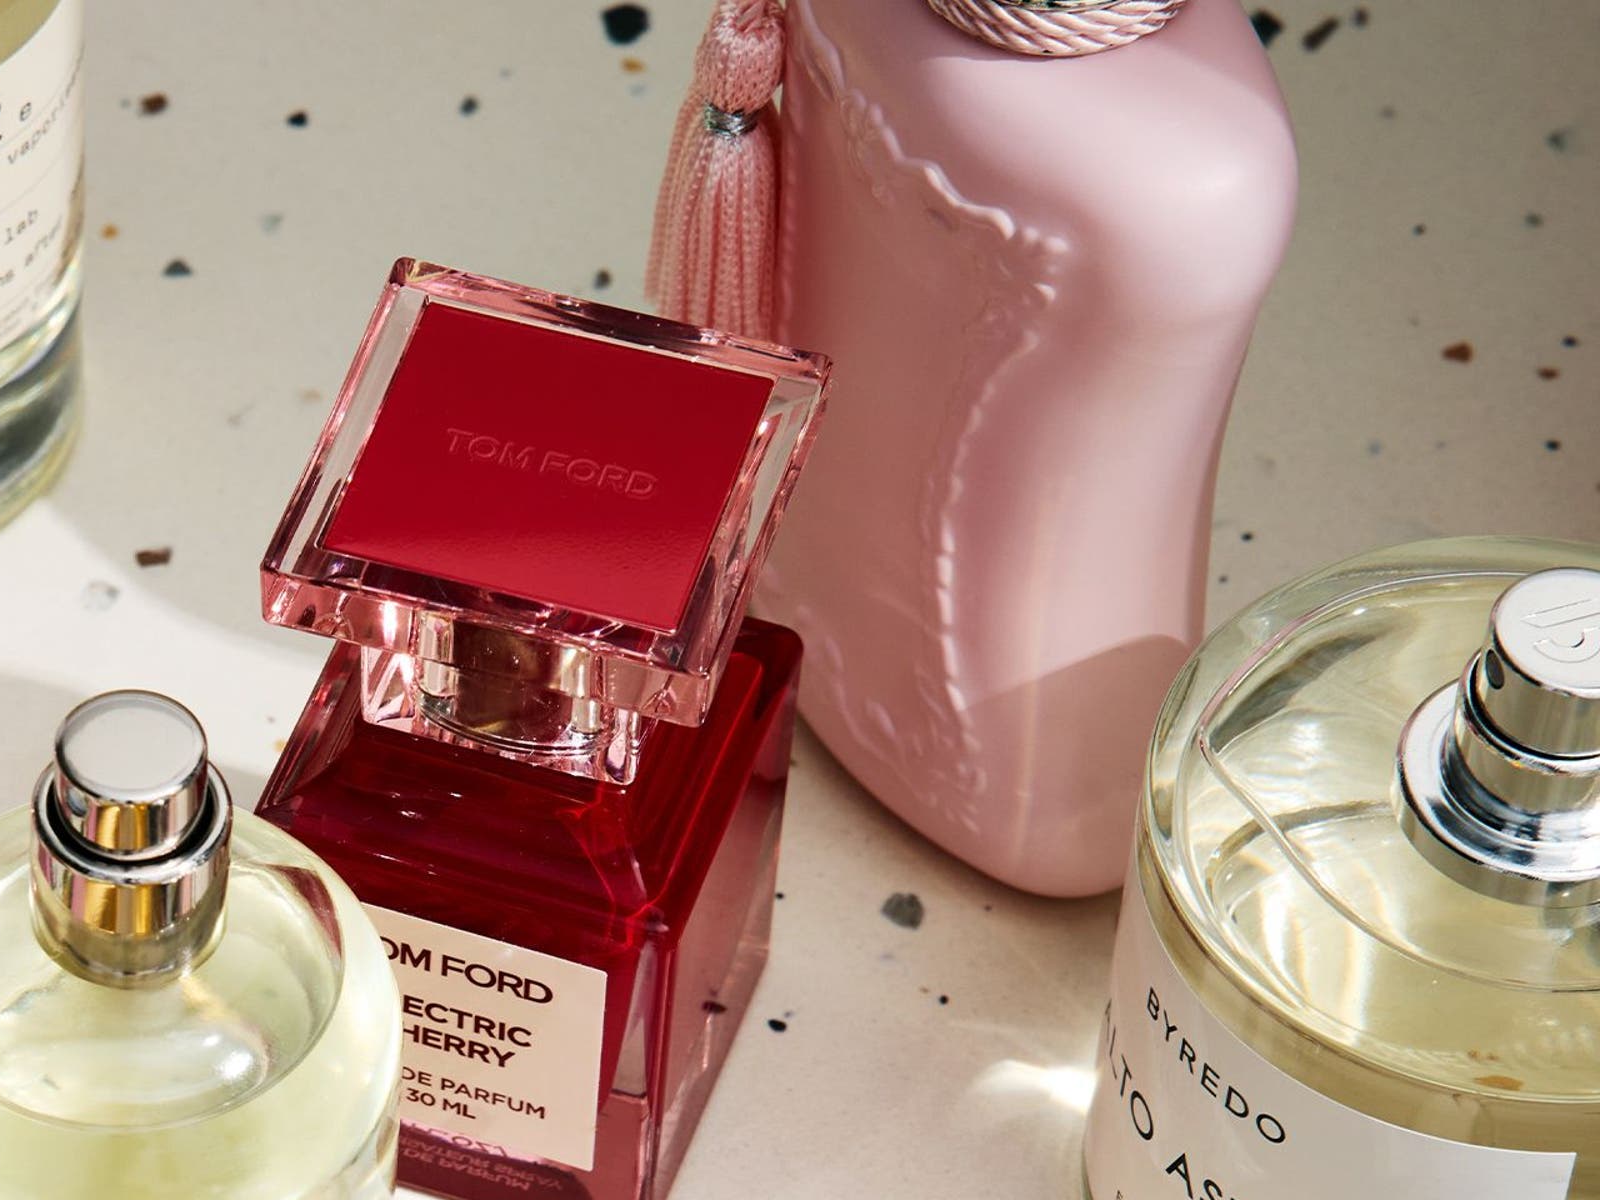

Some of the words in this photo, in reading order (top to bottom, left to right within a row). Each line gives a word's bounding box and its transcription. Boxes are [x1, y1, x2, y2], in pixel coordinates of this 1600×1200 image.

[4, 209, 38, 246] lab
[447, 427, 536, 470] TOM
[540, 450, 659, 497] FORD
[380, 936, 432, 972] OM
[441, 954, 553, 1004] FORD
[403, 995, 533, 1048] ECTRIC
[403, 1024, 516, 1068] HERRY
[1146, 987, 1287, 1145] BYREDO
[406, 1088, 436, 1106] 30
[443, 1099, 477, 1120] ML
[440, 1077, 546, 1119] PARFUM
